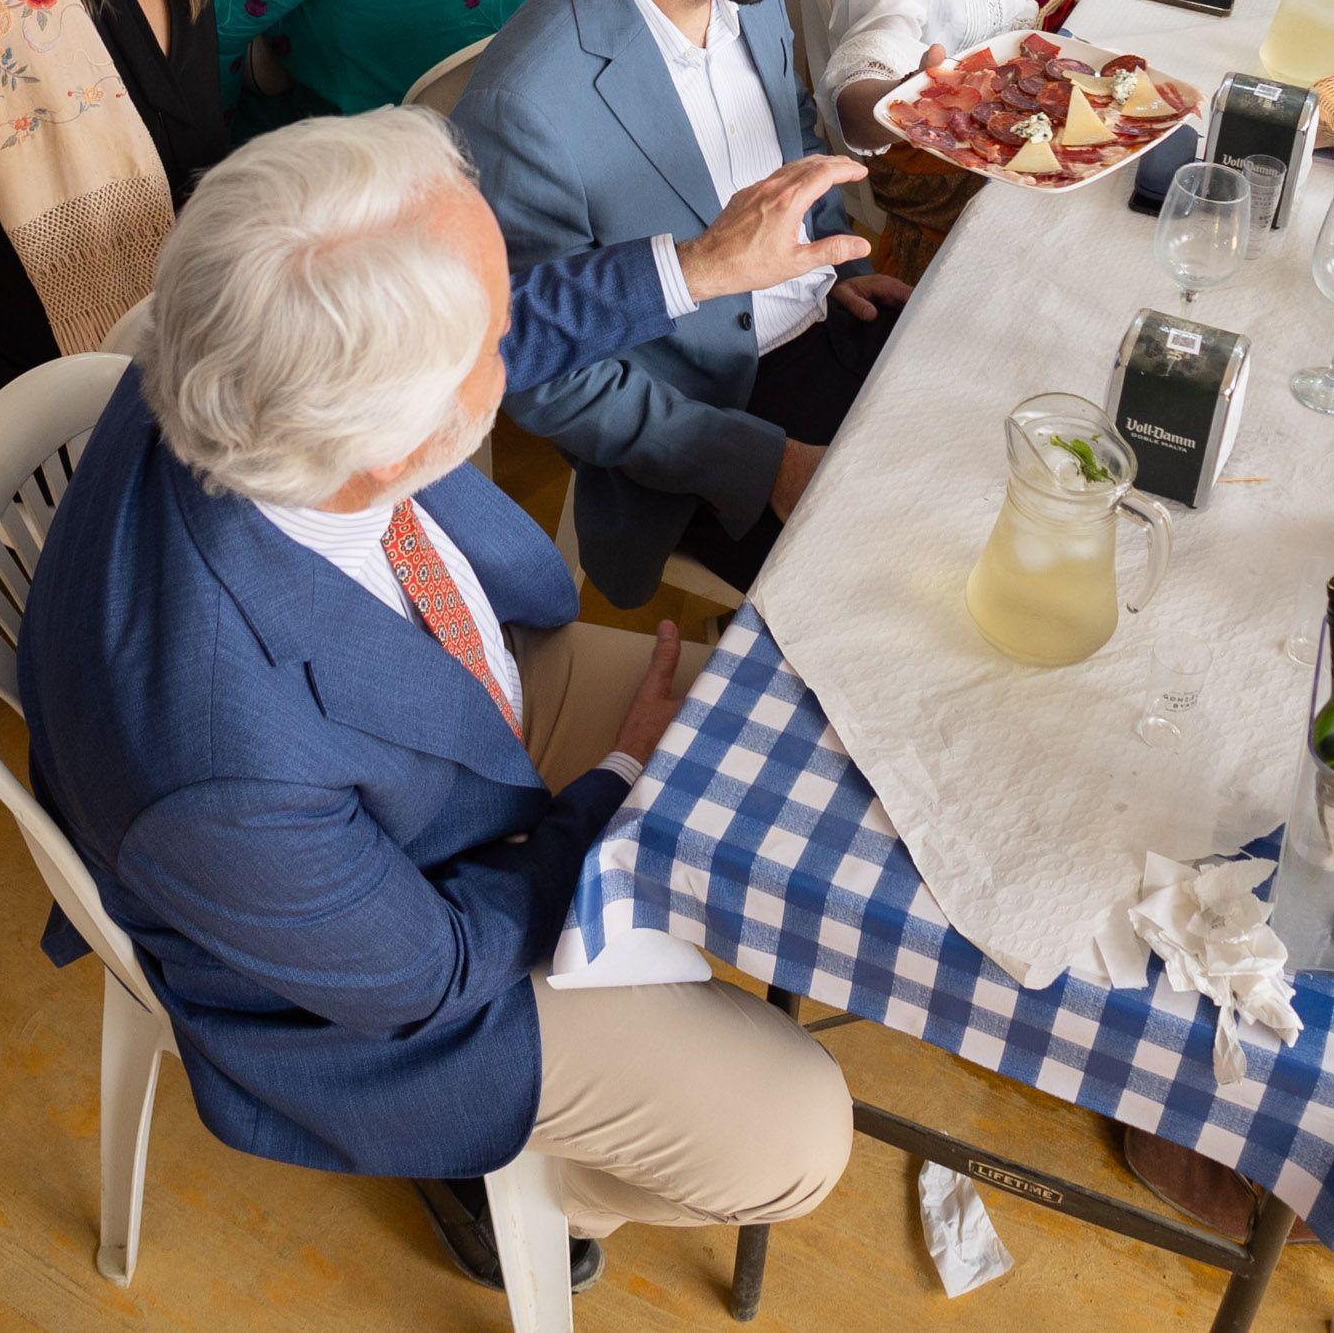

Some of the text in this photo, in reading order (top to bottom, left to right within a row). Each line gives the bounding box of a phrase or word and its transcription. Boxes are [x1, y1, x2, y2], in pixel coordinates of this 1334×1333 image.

[1126, 417, 1196, 449] Voll-Damm
[1131, 432, 1187, 453] DOBLE MALTA
[978, 1166, 1053, 1199] LIFETIME
